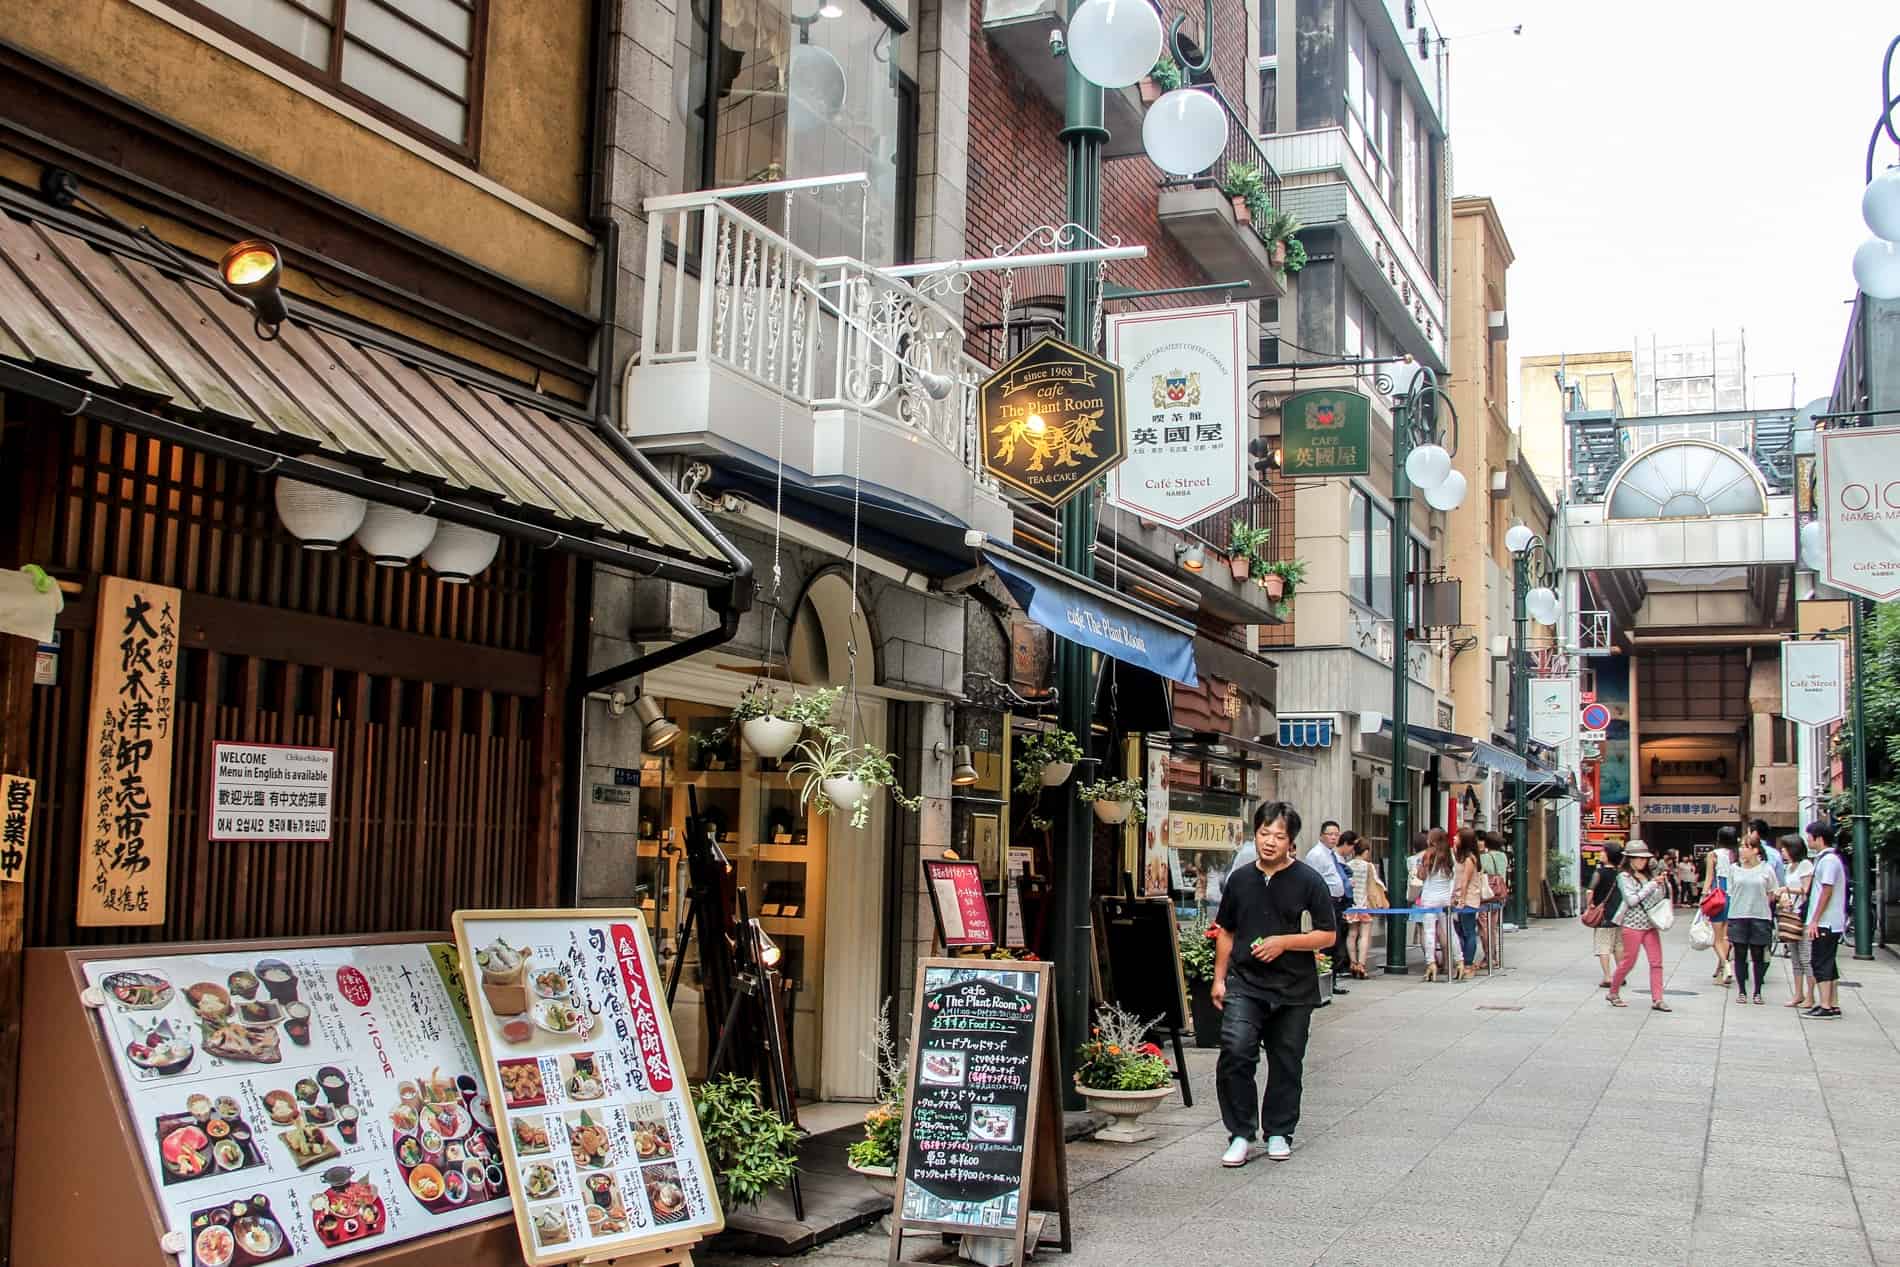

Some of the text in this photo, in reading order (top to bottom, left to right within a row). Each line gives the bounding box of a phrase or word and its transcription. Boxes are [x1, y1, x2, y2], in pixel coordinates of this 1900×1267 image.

[1023, 367, 1073, 382] since 1968
[1000, 398, 1104, 418] The Plant Room
[1131, 423, 1223, 445] 英國屋
[1174, 477, 1211, 488] Street
[1841, 512, 1881, 521] NAMBA
[1083, 609, 1103, 636] The
[1102, 617, 1124, 645] Plant
[111, 594, 159, 880] 大阪木津卸売市場
[220, 751, 267, 765] WELCOME
[220, 766, 327, 782] Menu in English is available
[218, 818, 232, 832] 어서
[236, 818, 265, 832] 오십시오
[961, 985, 986, 996] cafe
[945, 995, 1017, 1010] The Plant Room
[924, 1151, 946, 1167] 単品
